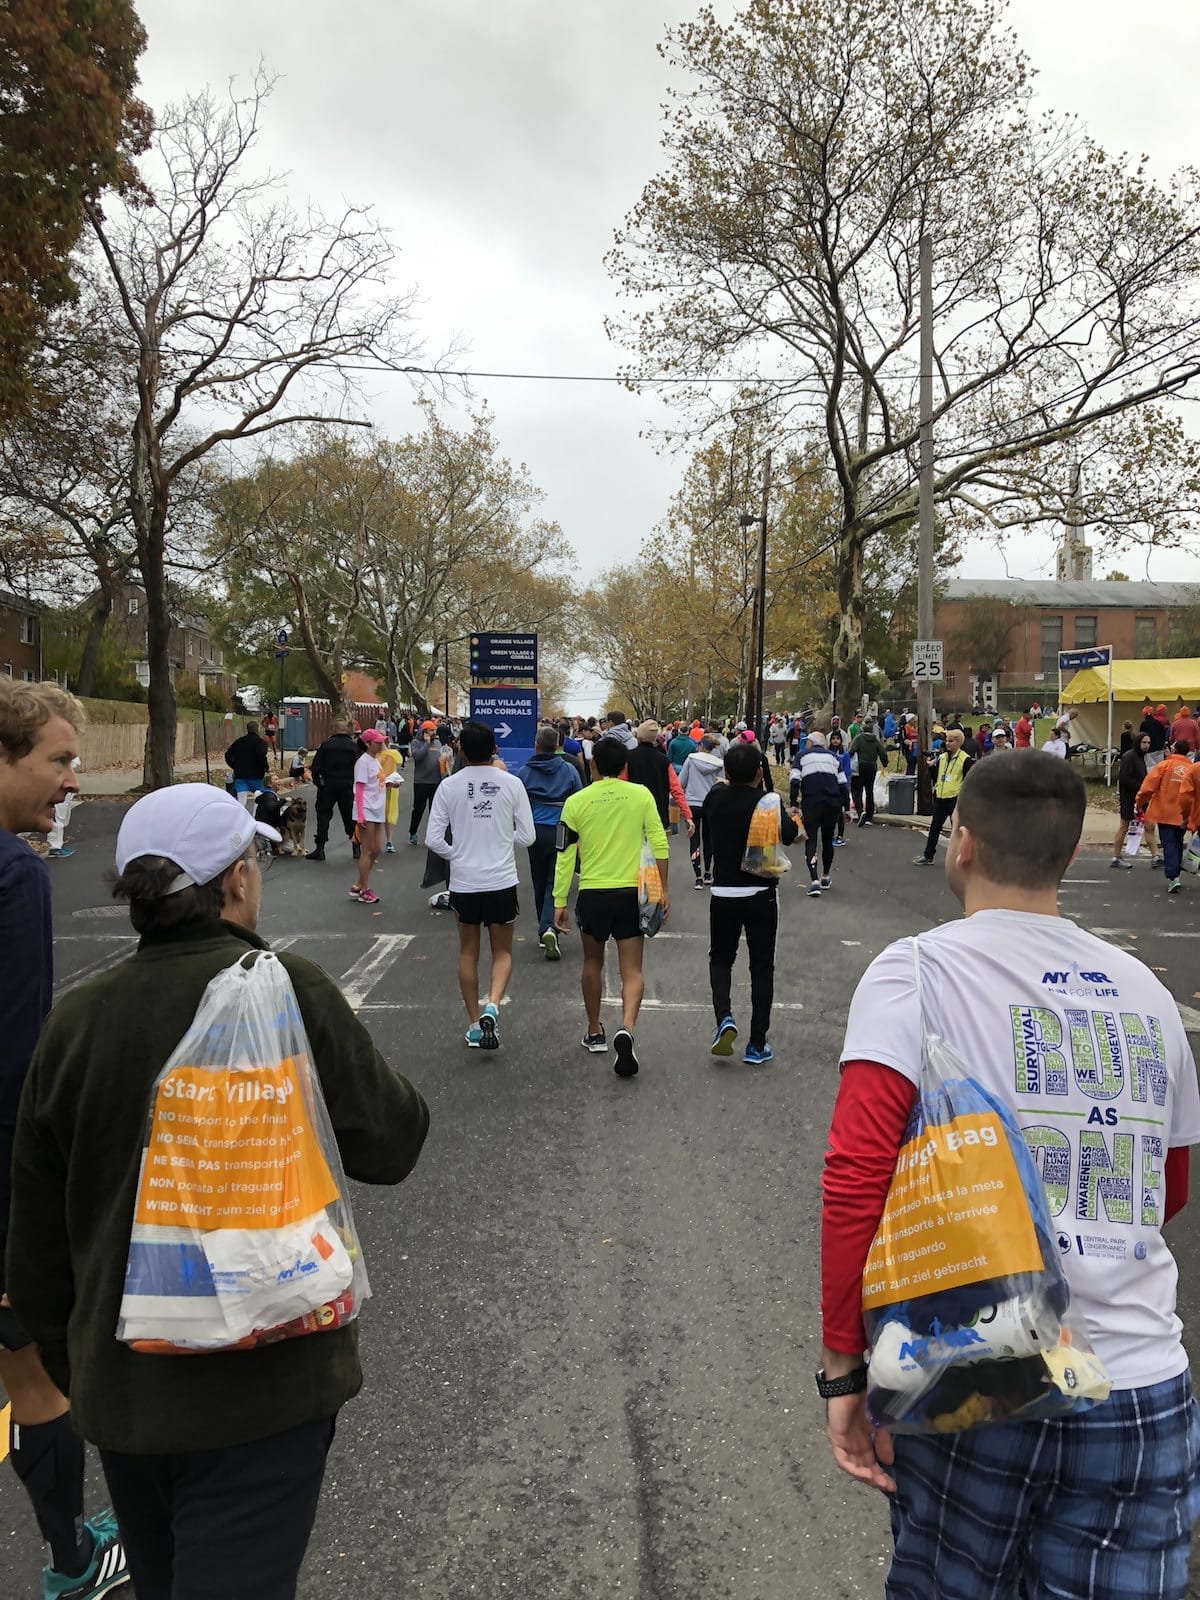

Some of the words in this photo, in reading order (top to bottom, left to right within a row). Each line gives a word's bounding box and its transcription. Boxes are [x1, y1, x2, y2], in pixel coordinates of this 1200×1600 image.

[915, 644, 941, 652] SPEED
[915, 661, 940, 676] 25
[497, 699, 532, 707] VILLAGE
[1070, 988, 1092, 997] FOR
[1095, 988, 1120, 997] LIFE
[1012, 1007, 1027, 1091] EDUCATION
[1022, 1008, 1039, 1092] SURVIVAL
[1073, 1043, 1092, 1053] TO
[1104, 1014, 1122, 1078] LUNGEVITY
[1129, 1045, 1152, 1057] CURE
[1076, 1069, 1096, 1079] WE
[163, 1077, 215, 1101] Start
[158, 1111, 177, 1122] NO
[225, 1117, 236, 1127] to
[239, 1114, 259, 1124] the
[1087, 1106, 1118, 1126] AS
[203, 1136, 277, 1150] transportado
[895, 1139, 937, 1176] illage
[946, 1126, 998, 1152] Bag
[153, 1155, 168, 1165] NE
[198, 1160, 220, 1171] PAS
[224, 1158, 285, 1171] transporté
[149, 1177, 175, 1188] NON
[217, 1183, 228, 1193] al
[231, 1181, 283, 1194] traguard
[1078, 1146, 1092, 1217] AWARENESS
[1101, 1176, 1131, 1185] DETECT
[923, 1189, 954, 1206] hasta
[955, 1185, 968, 1197] la
[971, 1178, 1004, 1193] meta
[1088, 1175, 1096, 1218] HONOR
[146, 1199, 177, 1212] WIRD
[180, 1203, 213, 1216] NICHT
[216, 1206, 242, 1216] zum
[245, 1204, 266, 1215] ziel
[937, 1215, 945, 1226] à
[946, 1204, 999, 1224] l'arrivée
[1107, 1207, 1131, 1215] LUNG
[1083, 1235, 1109, 1244] CENTRAL
[1110, 1237, 1126, 1245] PARK
[1084, 1242, 1127, 1252] CONSERVANCY
[885, 1256, 896, 1267] al
[889, 1276, 911, 1290] zum
[912, 1268, 931, 1284] ziel
[934, 1255, 989, 1280] gebracht
